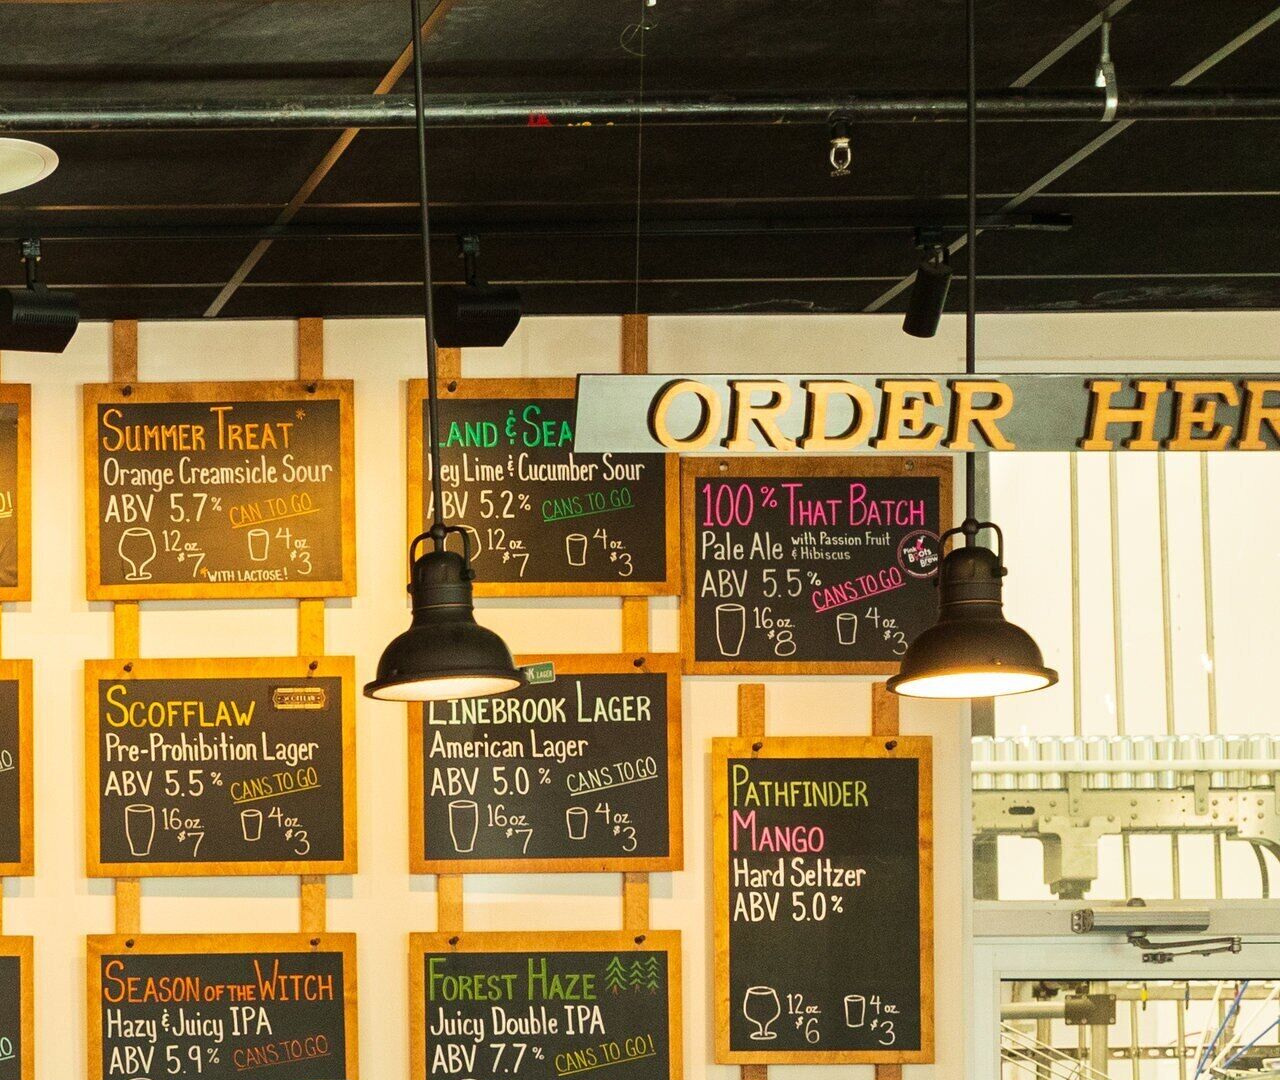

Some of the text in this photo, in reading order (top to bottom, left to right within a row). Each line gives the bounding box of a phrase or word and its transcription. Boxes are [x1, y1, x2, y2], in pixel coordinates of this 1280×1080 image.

[103, 409, 206, 451] SUMMER
[522, 405, 573, 447] SEA
[647, 378, 1016, 452] ORDER
[103, 454, 332, 492] Orange Creamsicle Sour
[464, 452, 644, 481] Lime Cucumber Sour
[703, 483, 924, 526] 100% THAT BATCH
[702, 531, 890, 560] Pale Ale with Passion Fruit
[801, 547, 851, 560] Hibiscus
[208, 569, 288, 582] WITH LACTOSE!
[106, 685, 255, 727] SCOFFLAW
[429, 681, 651, 725] LINEBROOK LAGER
[106, 732, 318, 767] Pre-Prohibition Lager
[430, 729, 588, 764] American Lager
[733, 764, 868, 807] PATHFINDER
[732, 809, 824, 853] MANGO
[733, 857, 866, 888] Hard Seltzer
[104, 959, 334, 1003] SEASON OF THE WITCH
[429, 958, 596, 1001] FOREST HAZE
[107, 1007, 272, 1044] Hazy Juicy IPA
[430, 1005, 605, 1043] Juicy Double IPA
